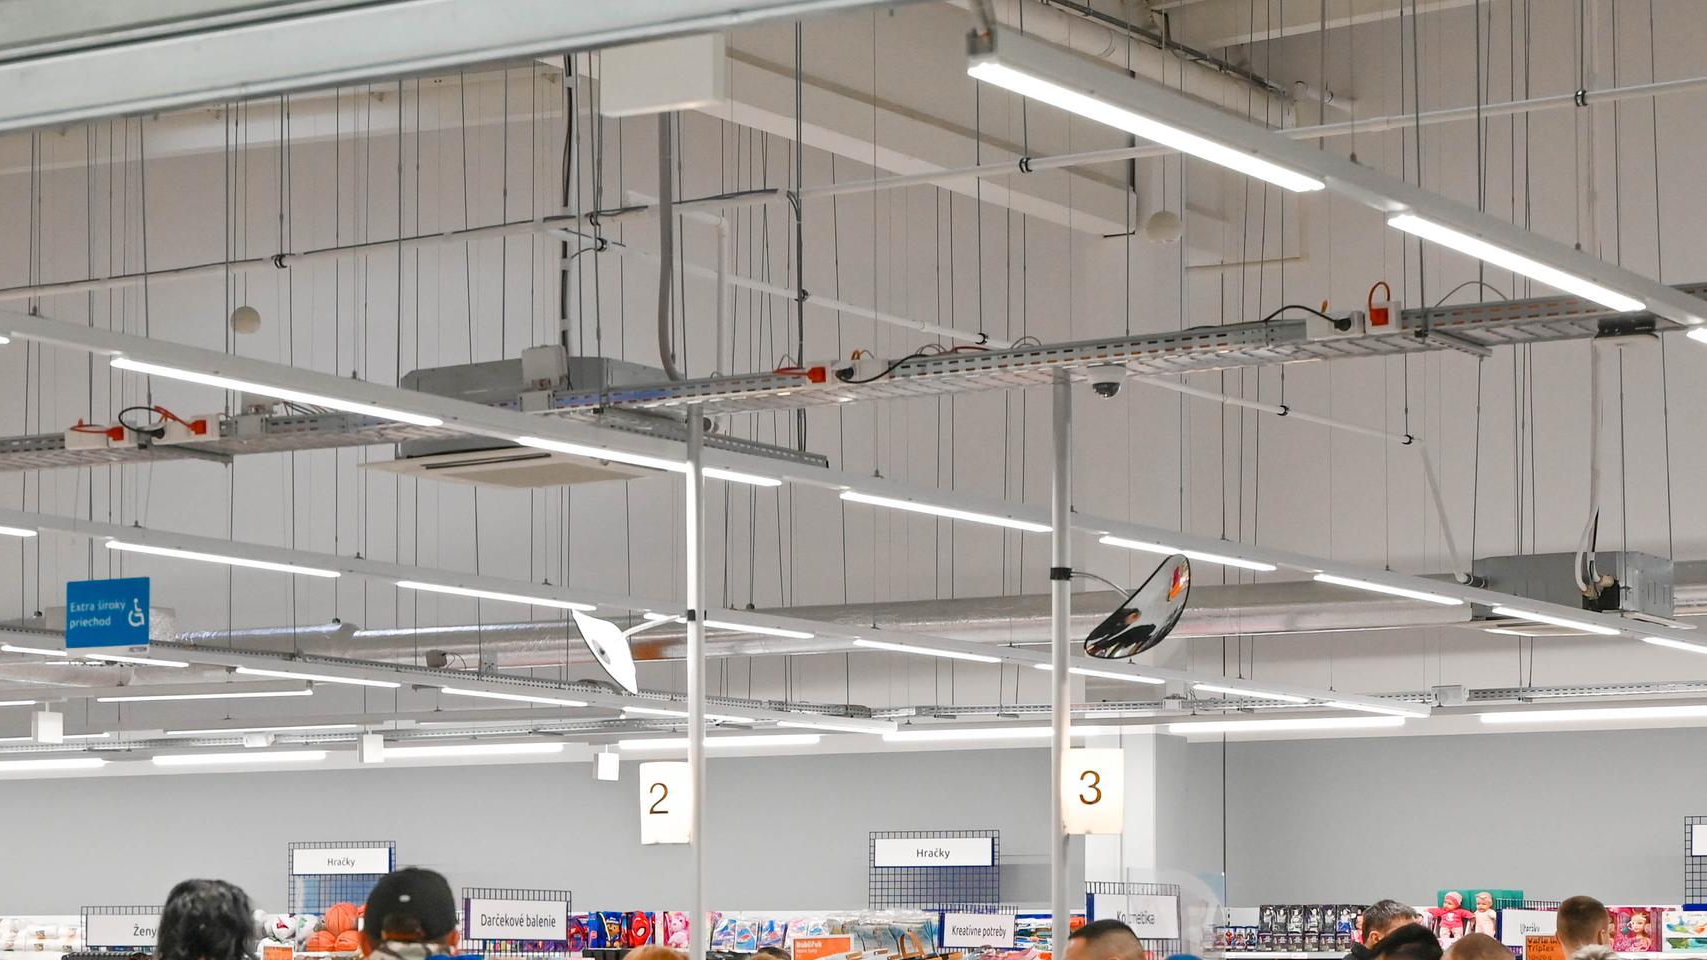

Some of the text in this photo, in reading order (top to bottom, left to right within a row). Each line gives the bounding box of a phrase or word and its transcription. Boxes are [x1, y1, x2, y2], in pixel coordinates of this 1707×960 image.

[70, 601, 95, 613] Extra
[69, 615, 111, 630] priechod
[1079, 770, 1102, 805] 3
[649, 782, 669, 815] 2
[915, 848, 951, 859] Hračky
[326, 857, 356, 867] Hračky
[480, 913, 557, 927] Darčekové balenie
[133, 924, 157, 939] Ženy
[951, 924, 1007, 939] Kreatívne potreby
